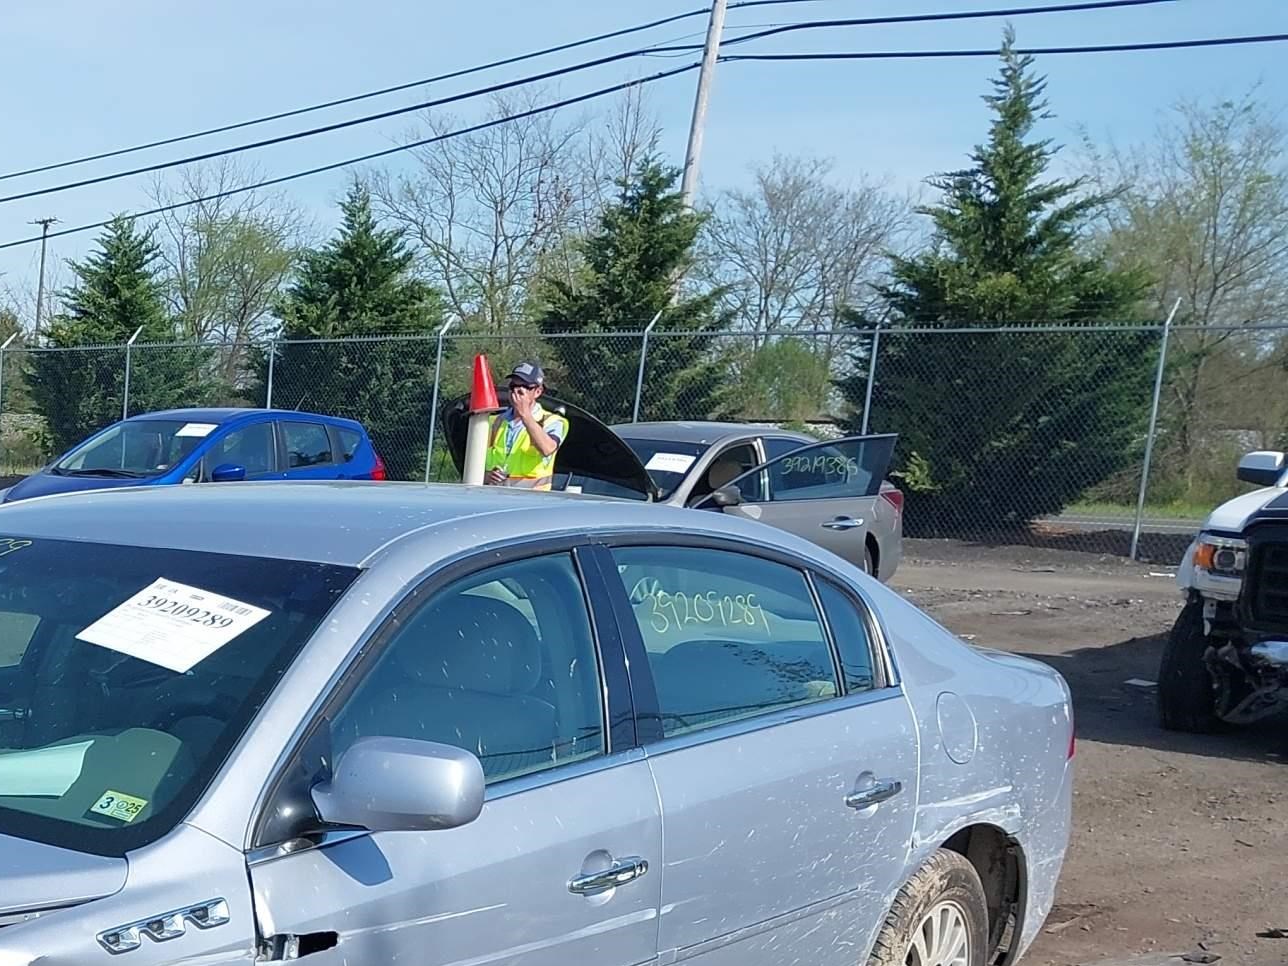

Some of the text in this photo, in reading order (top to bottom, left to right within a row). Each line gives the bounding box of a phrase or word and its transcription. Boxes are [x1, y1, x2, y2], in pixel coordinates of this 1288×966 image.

[137, 595, 235, 629] 39209289
[99, 796, 142, 814] 3 25
